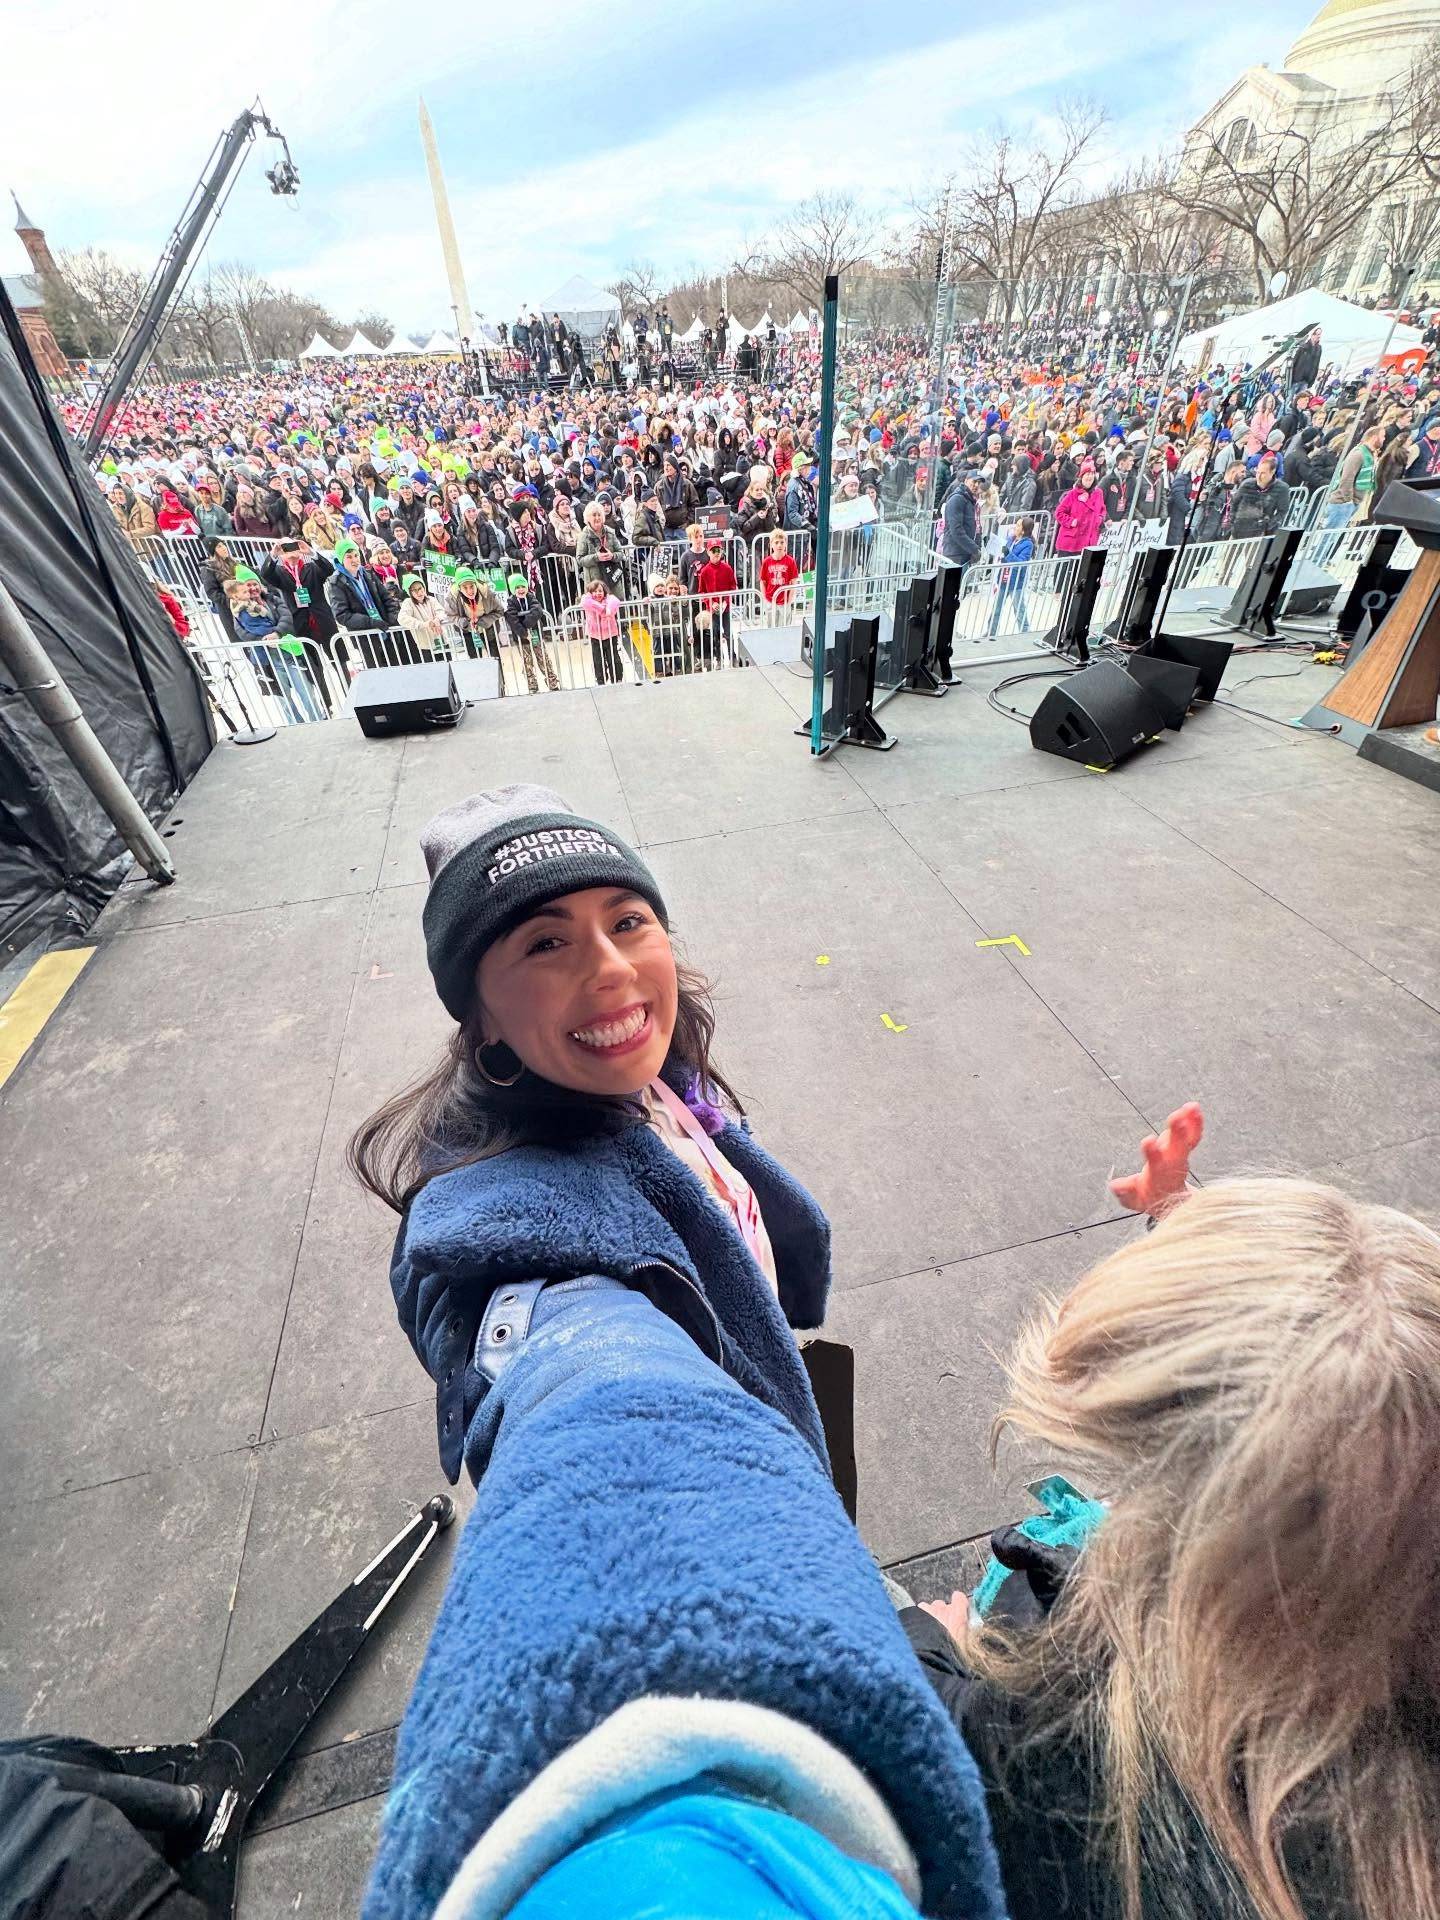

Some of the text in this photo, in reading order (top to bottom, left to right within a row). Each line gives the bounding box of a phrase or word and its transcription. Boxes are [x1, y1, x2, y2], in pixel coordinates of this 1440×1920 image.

[442, 555, 456, 566] LIFE
[495, 829, 604, 860] #JUSTICE
[488, 841, 621, 885] FORTHEFIVE
